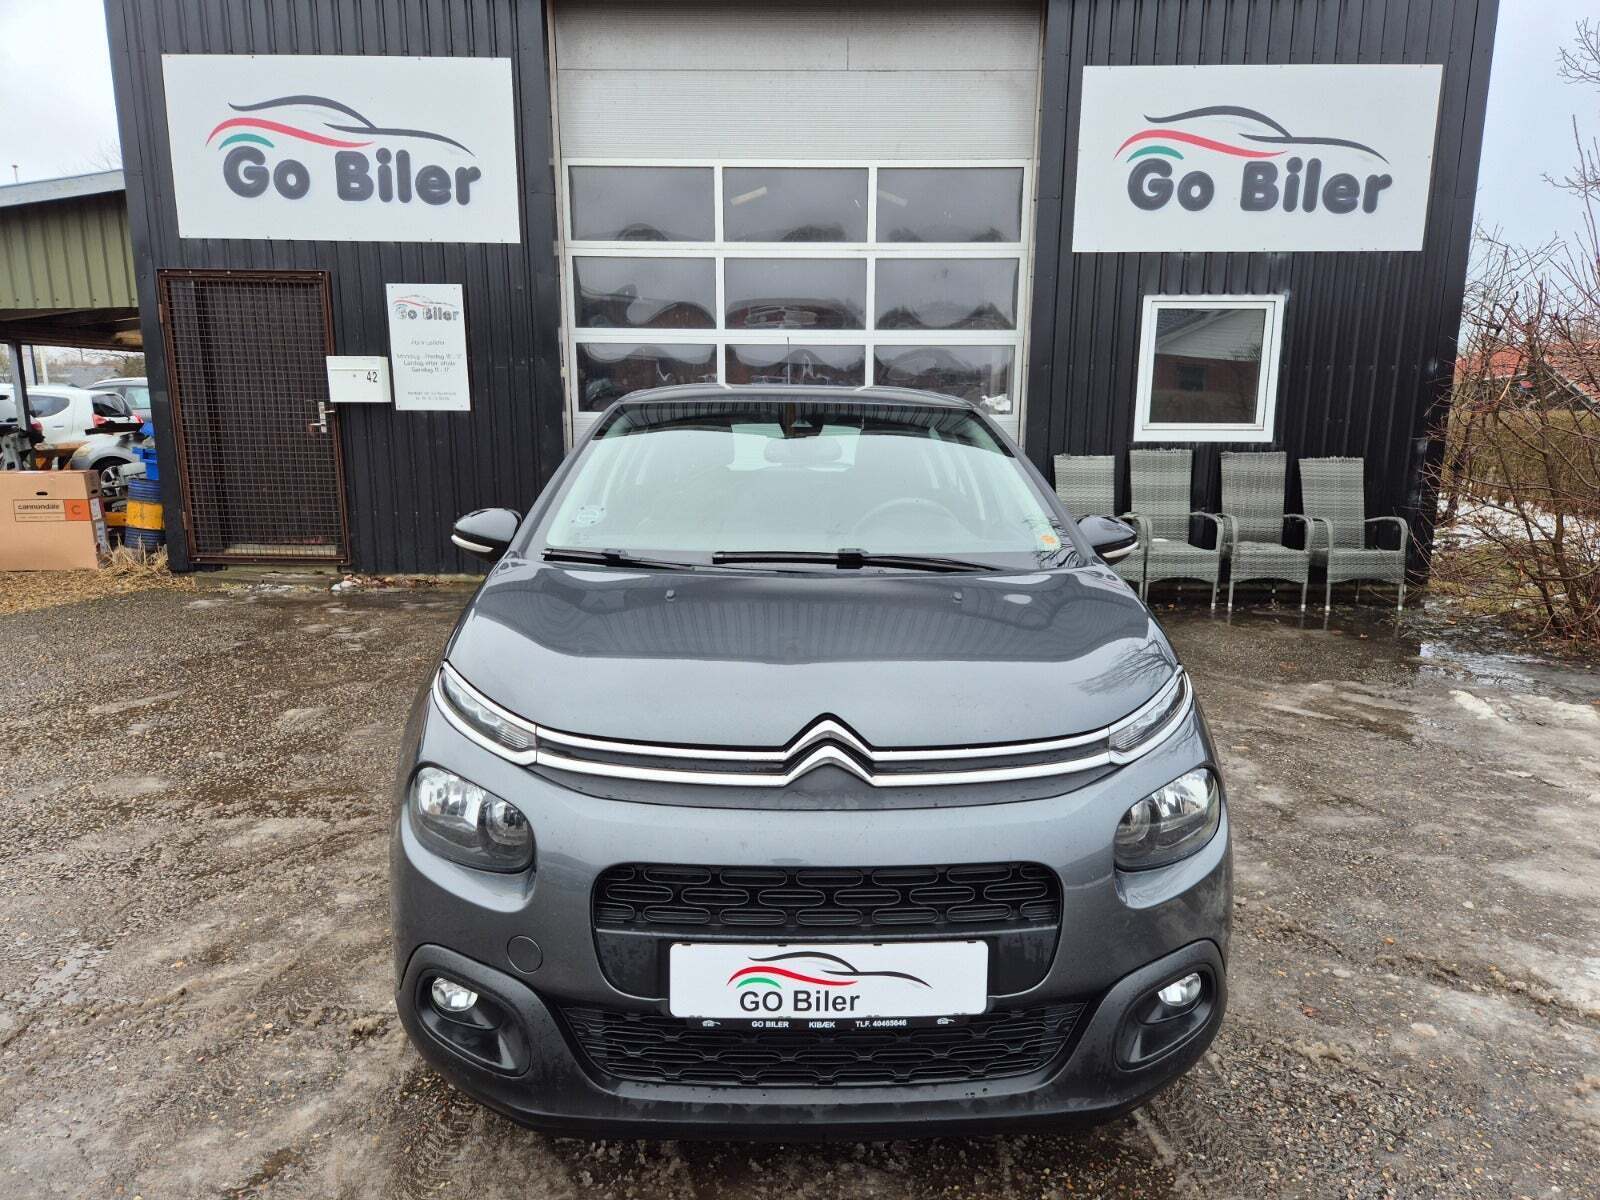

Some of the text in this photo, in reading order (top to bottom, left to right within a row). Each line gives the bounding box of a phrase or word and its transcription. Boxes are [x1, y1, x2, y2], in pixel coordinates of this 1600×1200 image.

[223, 145, 482, 206] Go Biler
[1127, 156, 1393, 214] Go Biler
[366, 370, 378, 383] 42
[739, 990, 861, 1012] GO Biler
[751, 1020, 764, 1028] GO
[765, 1020, 790, 1028] BILER
[808, 1021, 836, 1029] KIBÆK
[855, 1019, 872, 1028] TLF.
